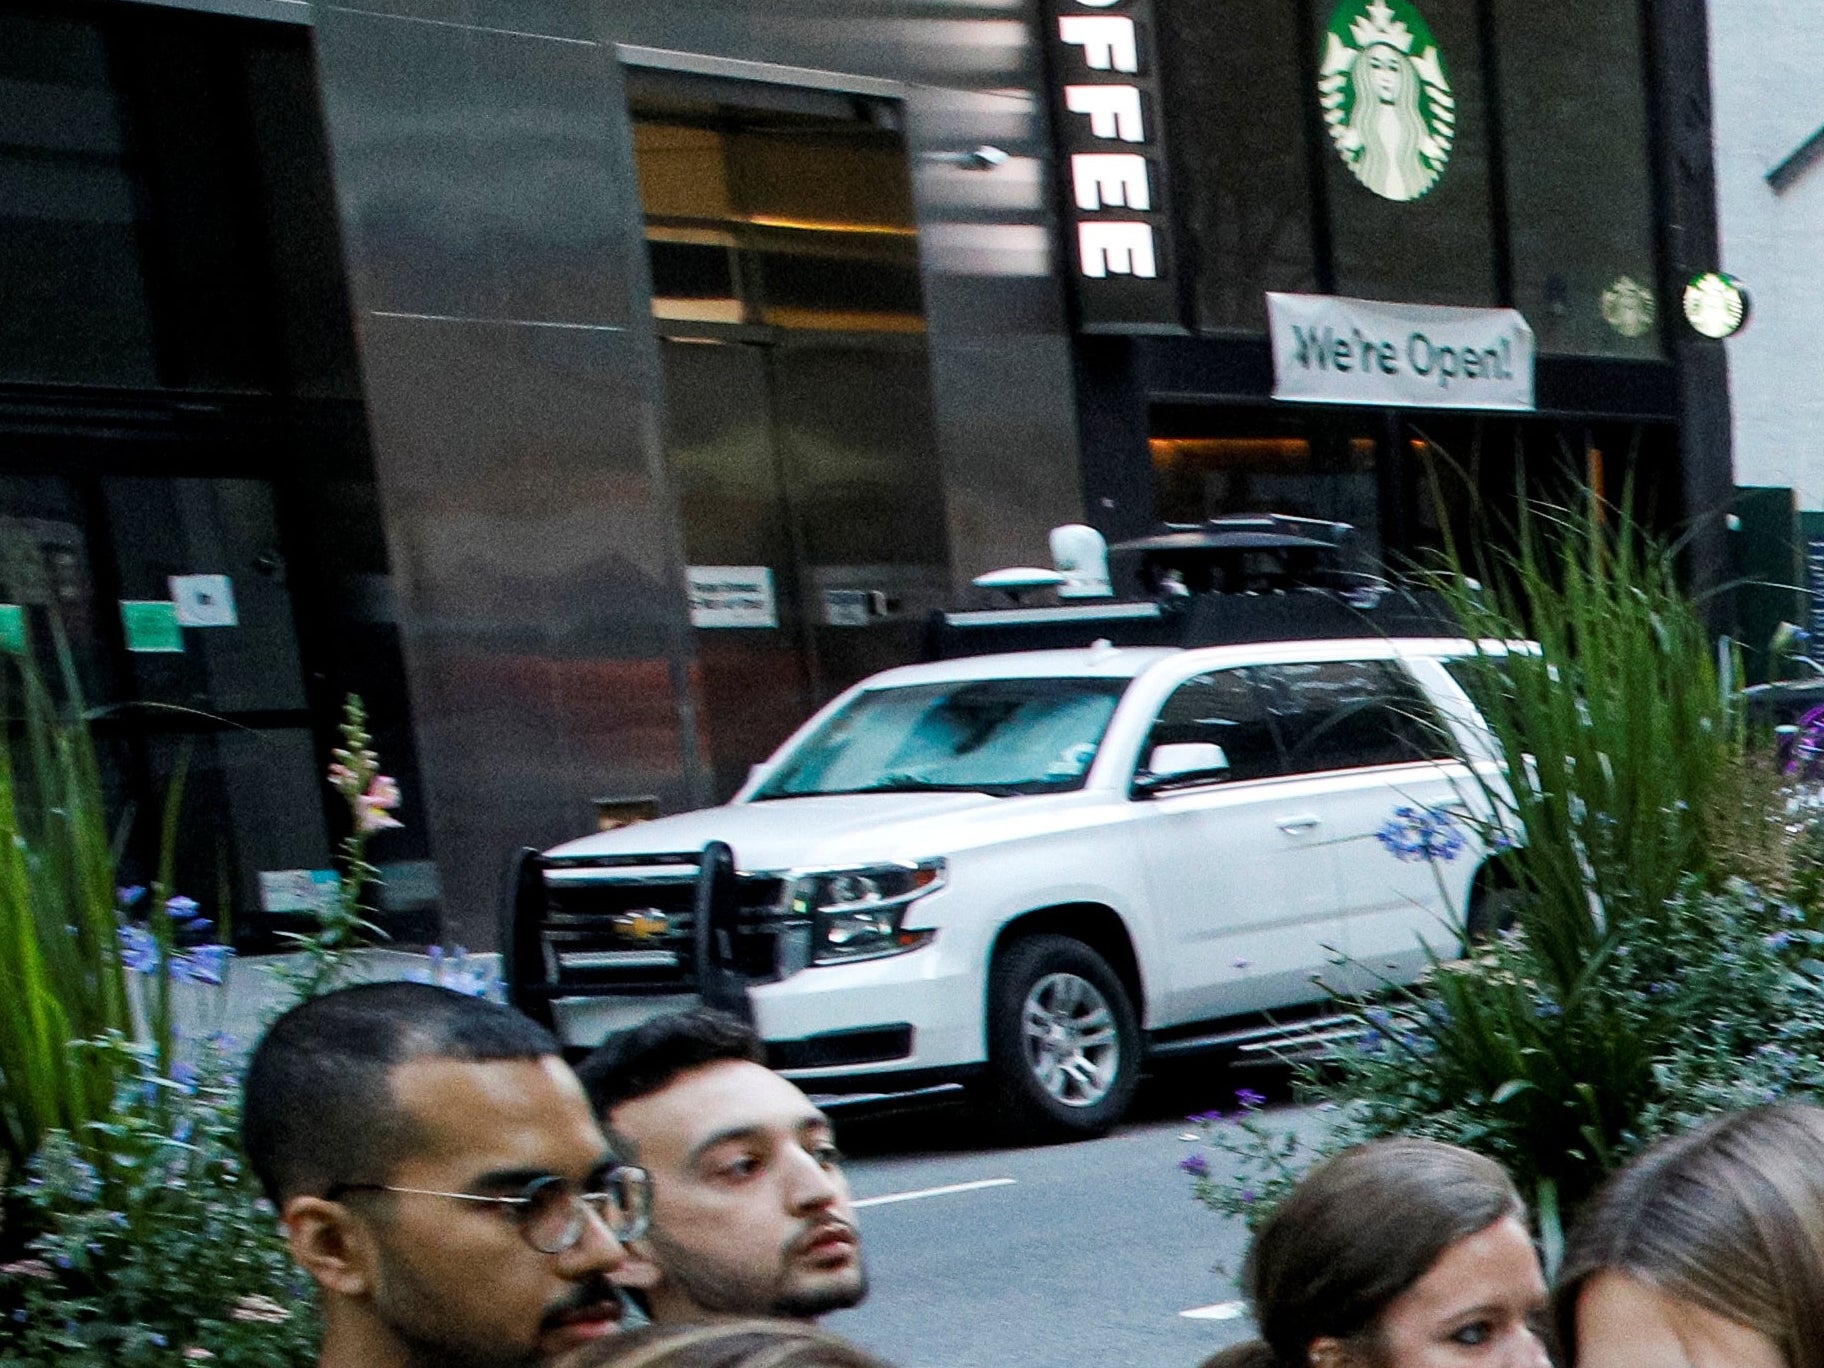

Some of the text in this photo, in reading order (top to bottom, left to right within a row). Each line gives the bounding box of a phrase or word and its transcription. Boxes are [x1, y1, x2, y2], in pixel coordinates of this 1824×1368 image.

[1057, 0, 1157, 278] FFEE
[1292, 324, 1514, 388] We're Open!
